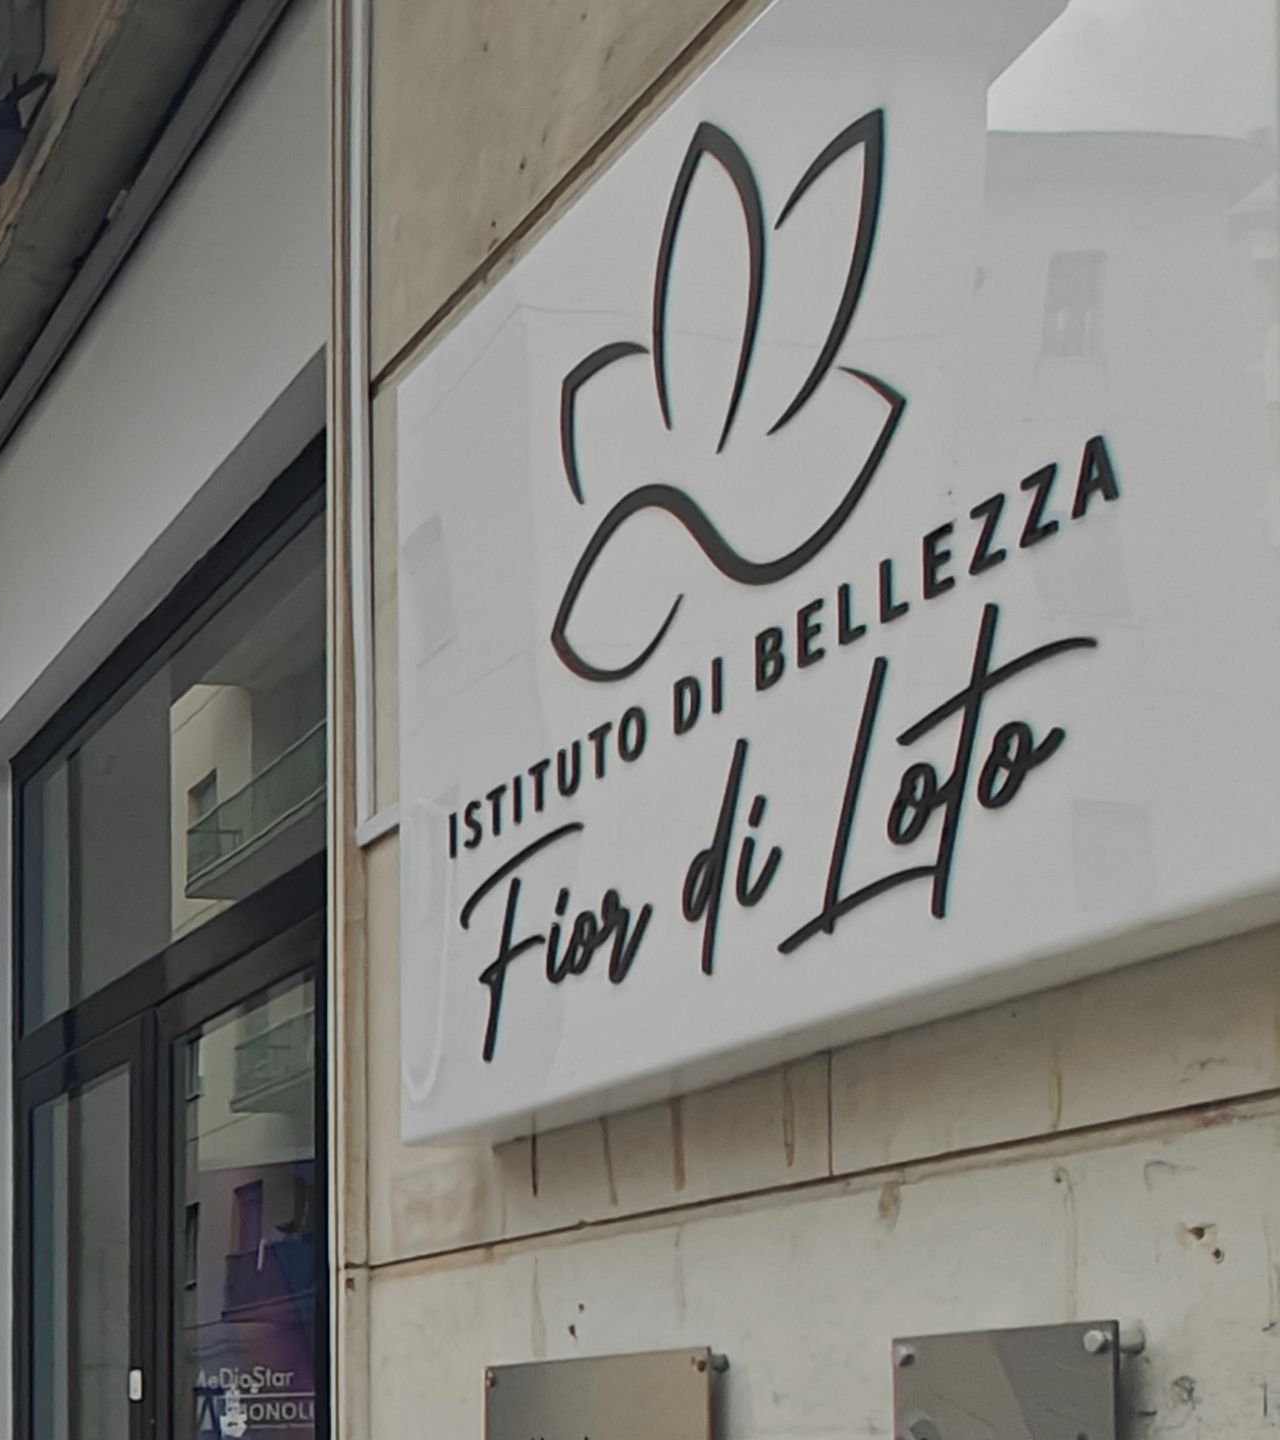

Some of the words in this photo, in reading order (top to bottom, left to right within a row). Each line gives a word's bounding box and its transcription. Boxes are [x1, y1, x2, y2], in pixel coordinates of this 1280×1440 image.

[447, 705, 647, 859] ISTITUTO
[672, 656, 725, 736] DI
[753, 434, 1119, 692] BELLEZZA
[459, 821, 655, 1063] Fior
[682, 738, 783, 975] di
[778, 602, 1098, 954] Loto
